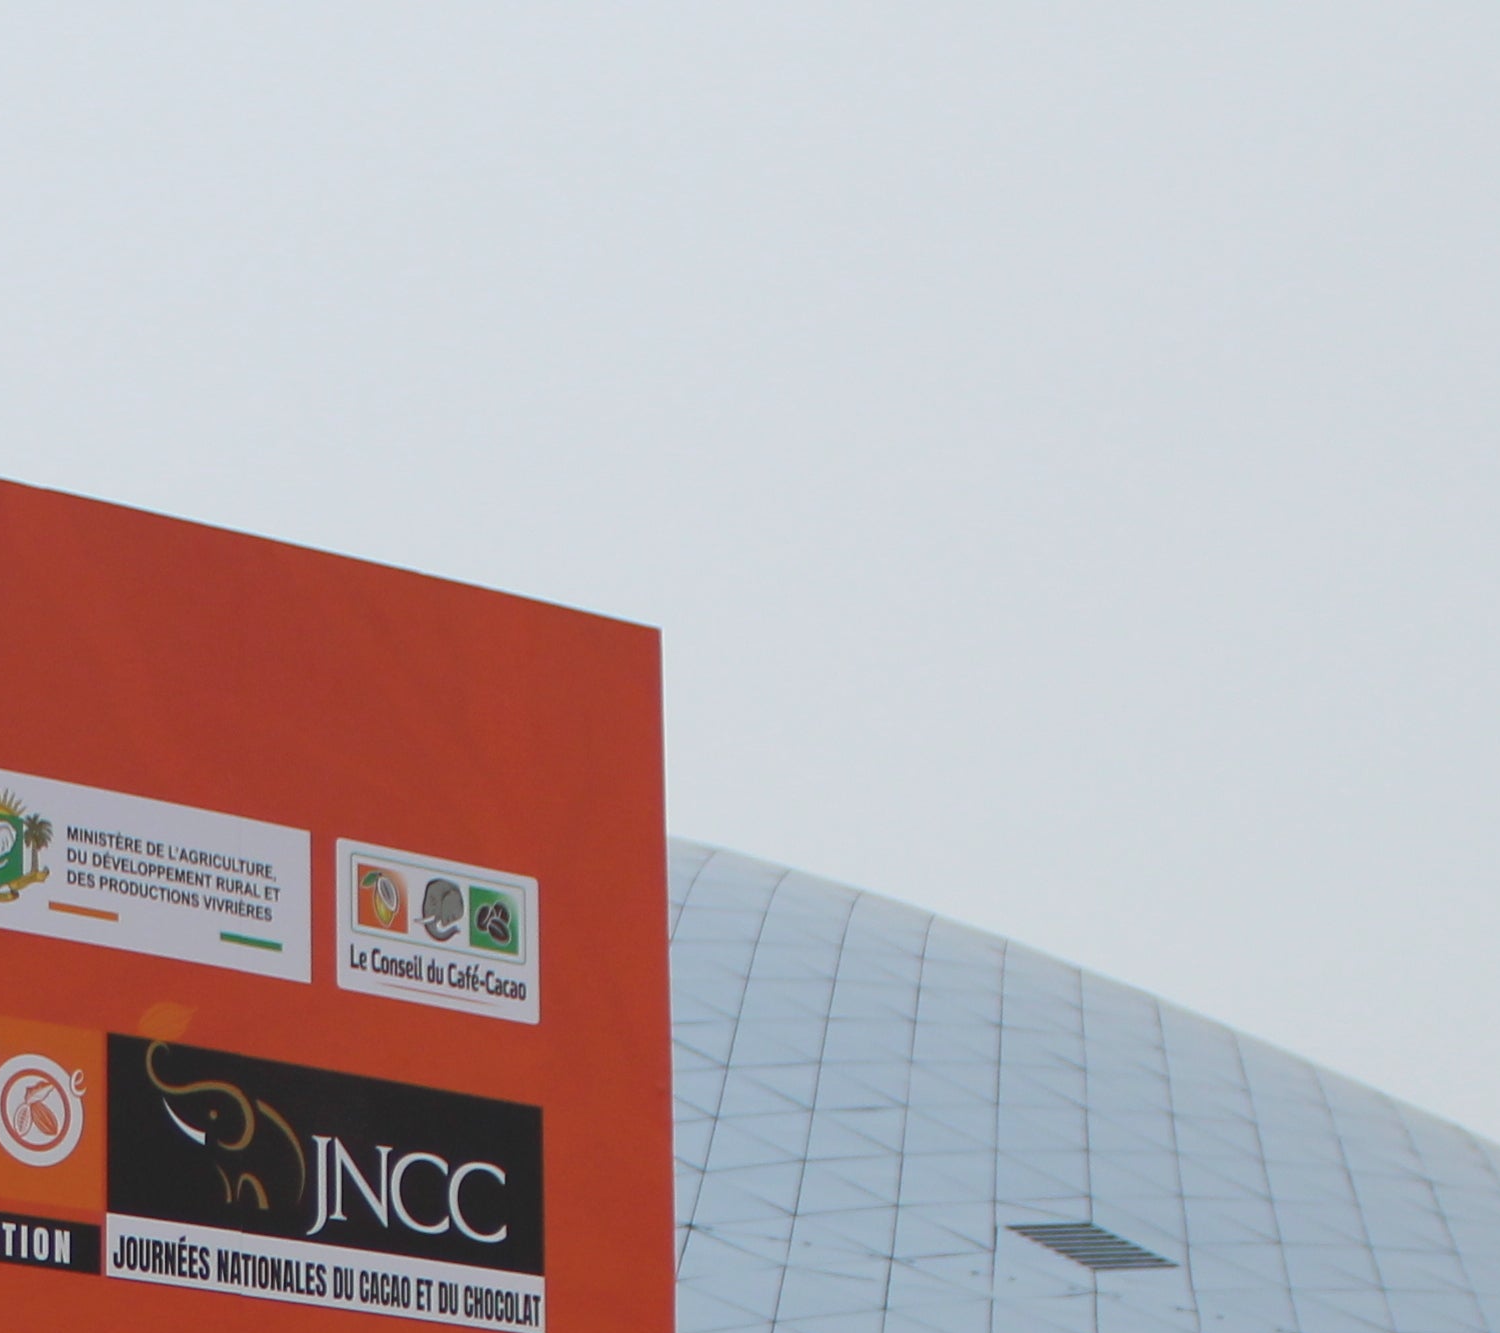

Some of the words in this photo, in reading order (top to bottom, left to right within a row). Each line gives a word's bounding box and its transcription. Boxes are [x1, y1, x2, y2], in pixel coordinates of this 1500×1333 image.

[67, 825, 143, 855] MINISTÈRE
[146, 840, 165, 859] DE
[168, 844, 278, 882] L'AGRICULTURE,
[67, 847, 88, 865] DU
[92, 852, 212, 888] DÉVELOPPEMENT
[216, 876, 261, 899] RURAL
[264, 886, 281, 902] ET
[67, 869, 96, 889] DES
[100, 876, 200, 909] PRODUCTIONS
[203, 894, 273, 922] VIVRIÈRES
[350, 943, 367, 969] Le
[371, 948, 423, 981] Conseil
[427, 958, 444, 985] du
[448, 963, 527, 1001] Café-Cacao
[306, 1133, 507, 1244] JNCC
[113, 1235, 211, 1281] JOURNÉES
[216, 1249, 327, 1298] NATIONALES
[333, 1268, 355, 1302] DU
[359, 1270, 411, 1309] CACAO
[416, 1279, 434, 1312] ET
[438, 1283, 459, 1315] DU
[464, 1286, 542, 1328] CHOCOLAT
